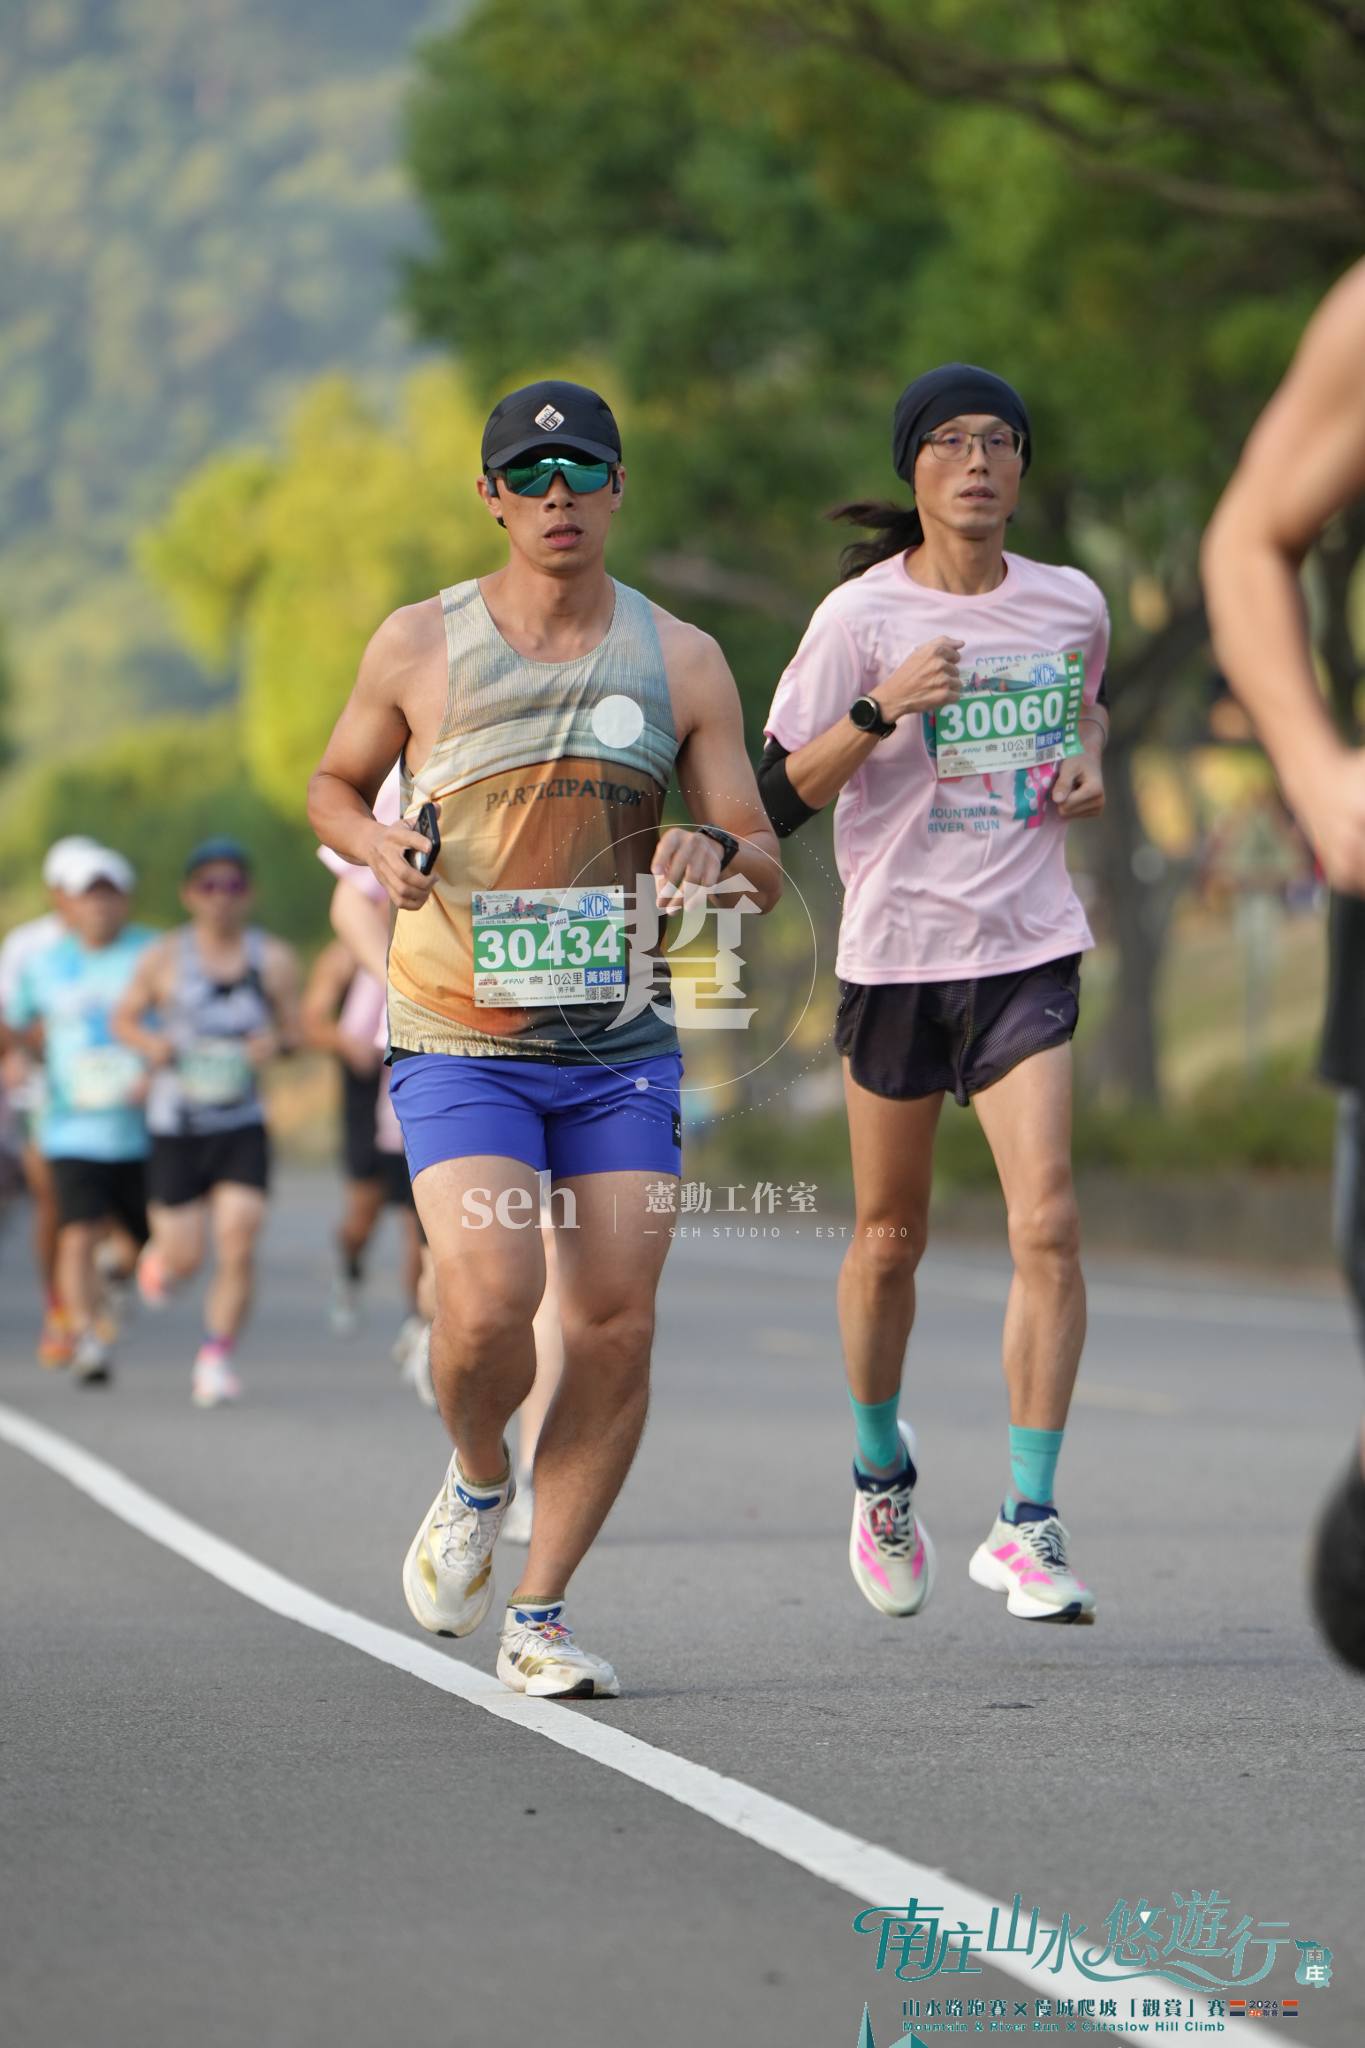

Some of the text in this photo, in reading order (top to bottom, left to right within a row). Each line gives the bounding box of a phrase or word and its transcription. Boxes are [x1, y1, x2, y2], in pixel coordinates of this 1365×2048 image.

[940, 691, 1063, 741] 30060
[974, 820, 999, 832] RUN
[477, 924, 621, 970] 30434
[548, 972, 583, 985] 10公里
